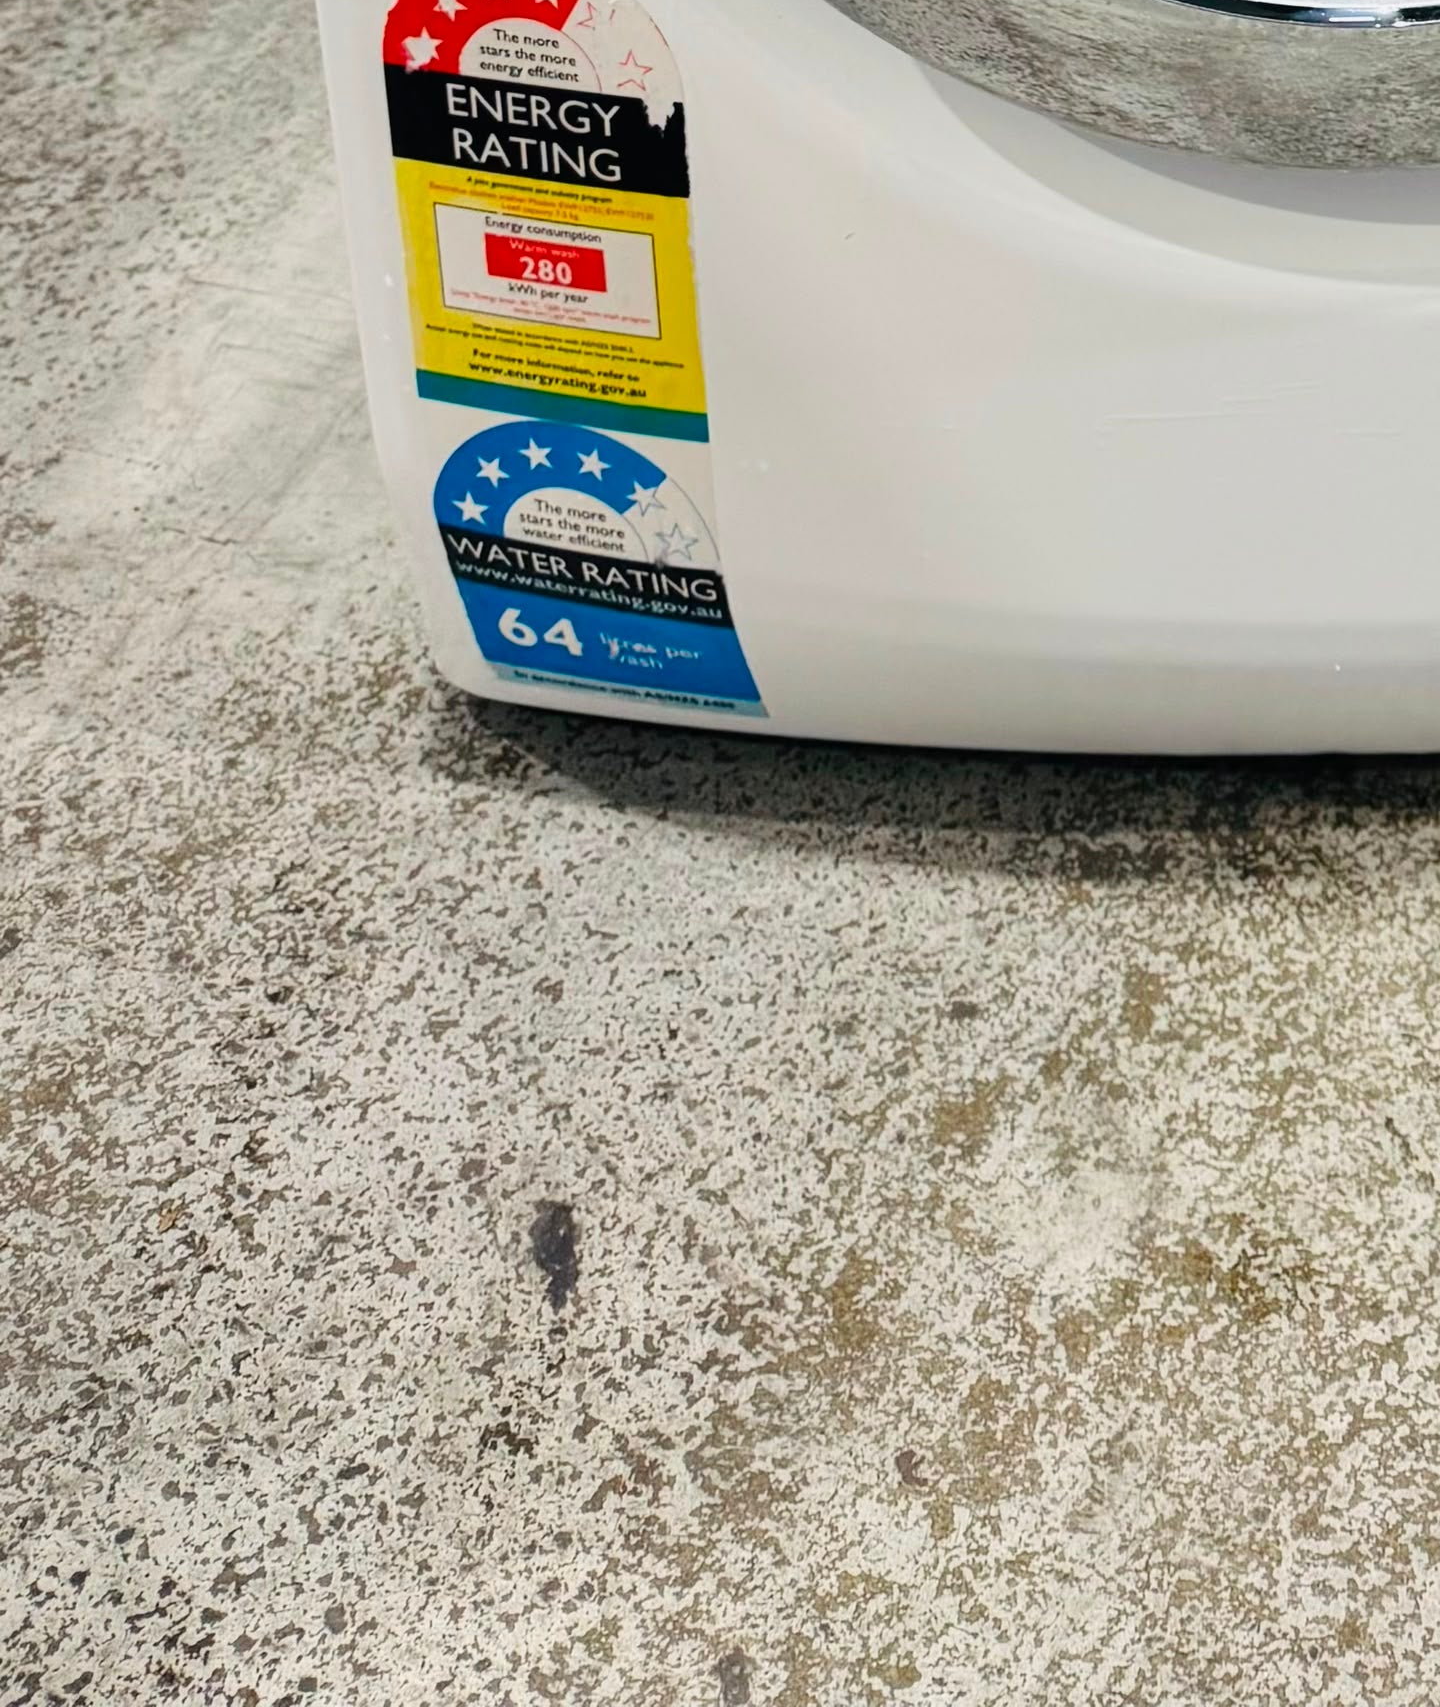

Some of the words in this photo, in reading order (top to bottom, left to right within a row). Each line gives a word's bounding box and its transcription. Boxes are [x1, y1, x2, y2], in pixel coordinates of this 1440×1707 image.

[493, 28, 519, 43] The
[523, 36, 560, 48] more
[480, 46, 510, 58] stars
[515, 48, 536, 61] the
[540, 53, 576, 67] more
[480, 61, 523, 78] energy
[527, 65, 580, 83] efficient
[446, 82, 621, 137] ENERGY
[452, 127, 622, 182] RATING
[485, 216, 523, 234] Energy
[527, 225, 602, 243] consumption
[509, 238, 547, 254] Warm
[551, 249, 580, 258] wash
[519, 256, 573, 285] 280
[508, 282, 538, 295] kWh
[540, 289, 560, 300] per
[564, 293, 588, 304] year
[473, 348, 491, 359] For
[494, 353, 523, 364] more
[597, 370, 624, 381] refer
[627, 374, 640, 382] to
[469, 362, 646, 398] www.energyrating.gov.au
[534, 498, 562, 514] The
[567, 507, 606, 522] more
[520, 513, 553, 527] stars
[558, 518, 581, 531] the
[586, 525, 625, 538] more
[523, 527, 564, 542] water
[568, 534, 625, 552] efficient
[448, 534, 573, 579] WATER
[581, 561, 718, 601] RATING
[456, 561, 723, 621] www.waterrating.gov.au
[498, 607, 583, 657] 64
